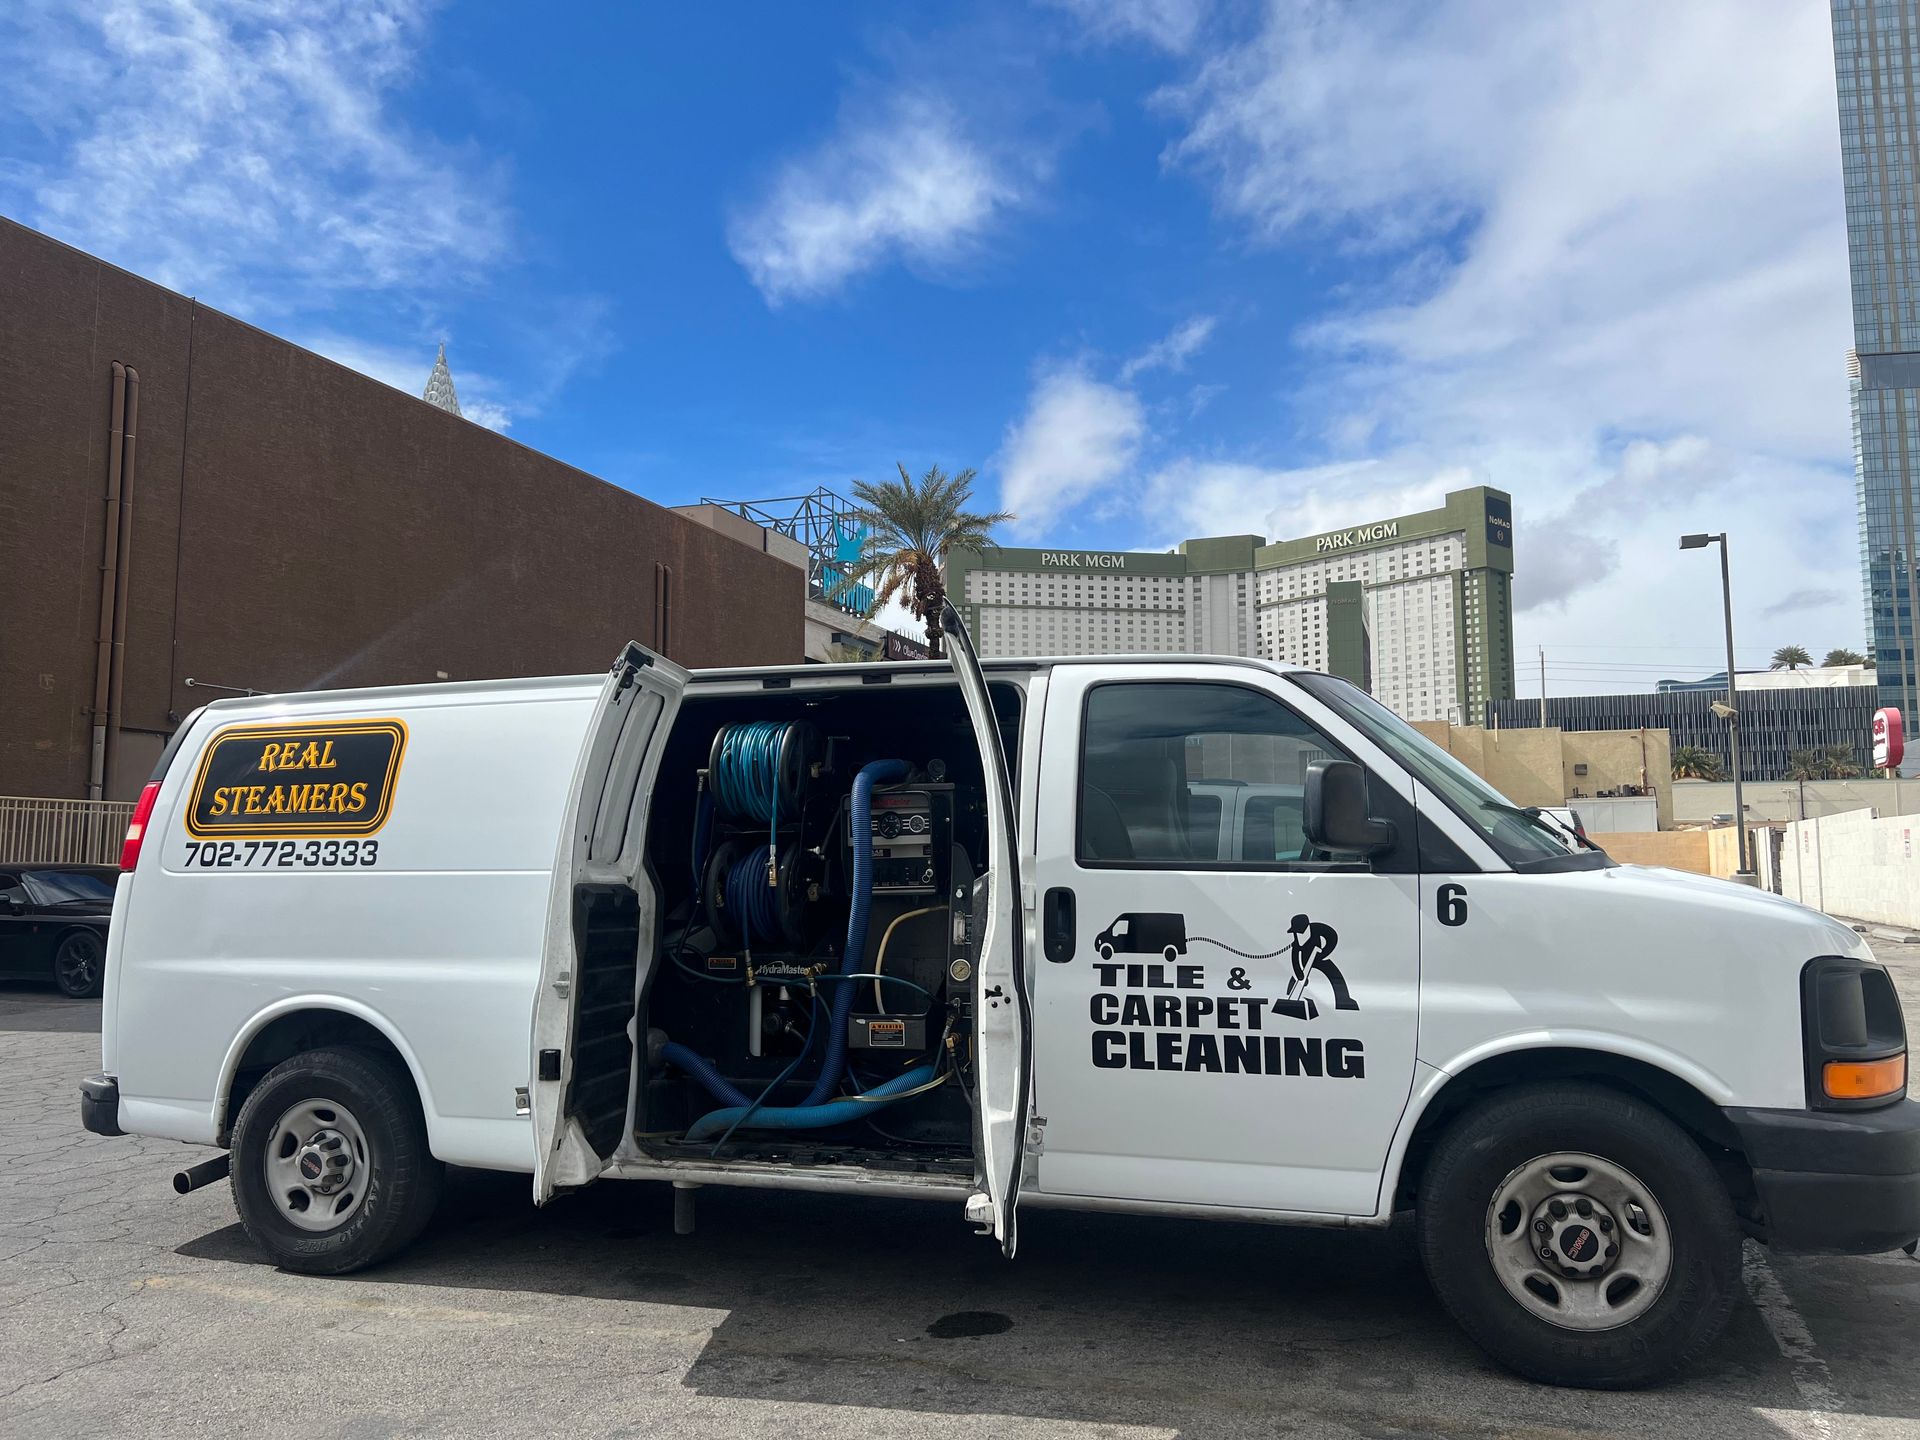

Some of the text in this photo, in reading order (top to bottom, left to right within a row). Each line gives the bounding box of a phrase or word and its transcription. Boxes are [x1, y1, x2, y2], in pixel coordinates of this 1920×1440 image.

[1316, 521, 1398, 552] PARK MGM
[1041, 552, 1125, 569] PARK MGM
[258, 740, 337, 772] REAL
[209, 782, 368, 816] STEAMERS
[184, 840, 379, 867] 702-772-3333
[1436, 883, 1468, 927] 6
[759, 964, 806, 975] HydraMaste
[1092, 963, 1252, 991] TILE &
[1089, 993, 1269, 1030] CARPET
[1091, 1030, 1365, 1079] CLEANING
[1567, 1228, 1590, 1259] GMC
